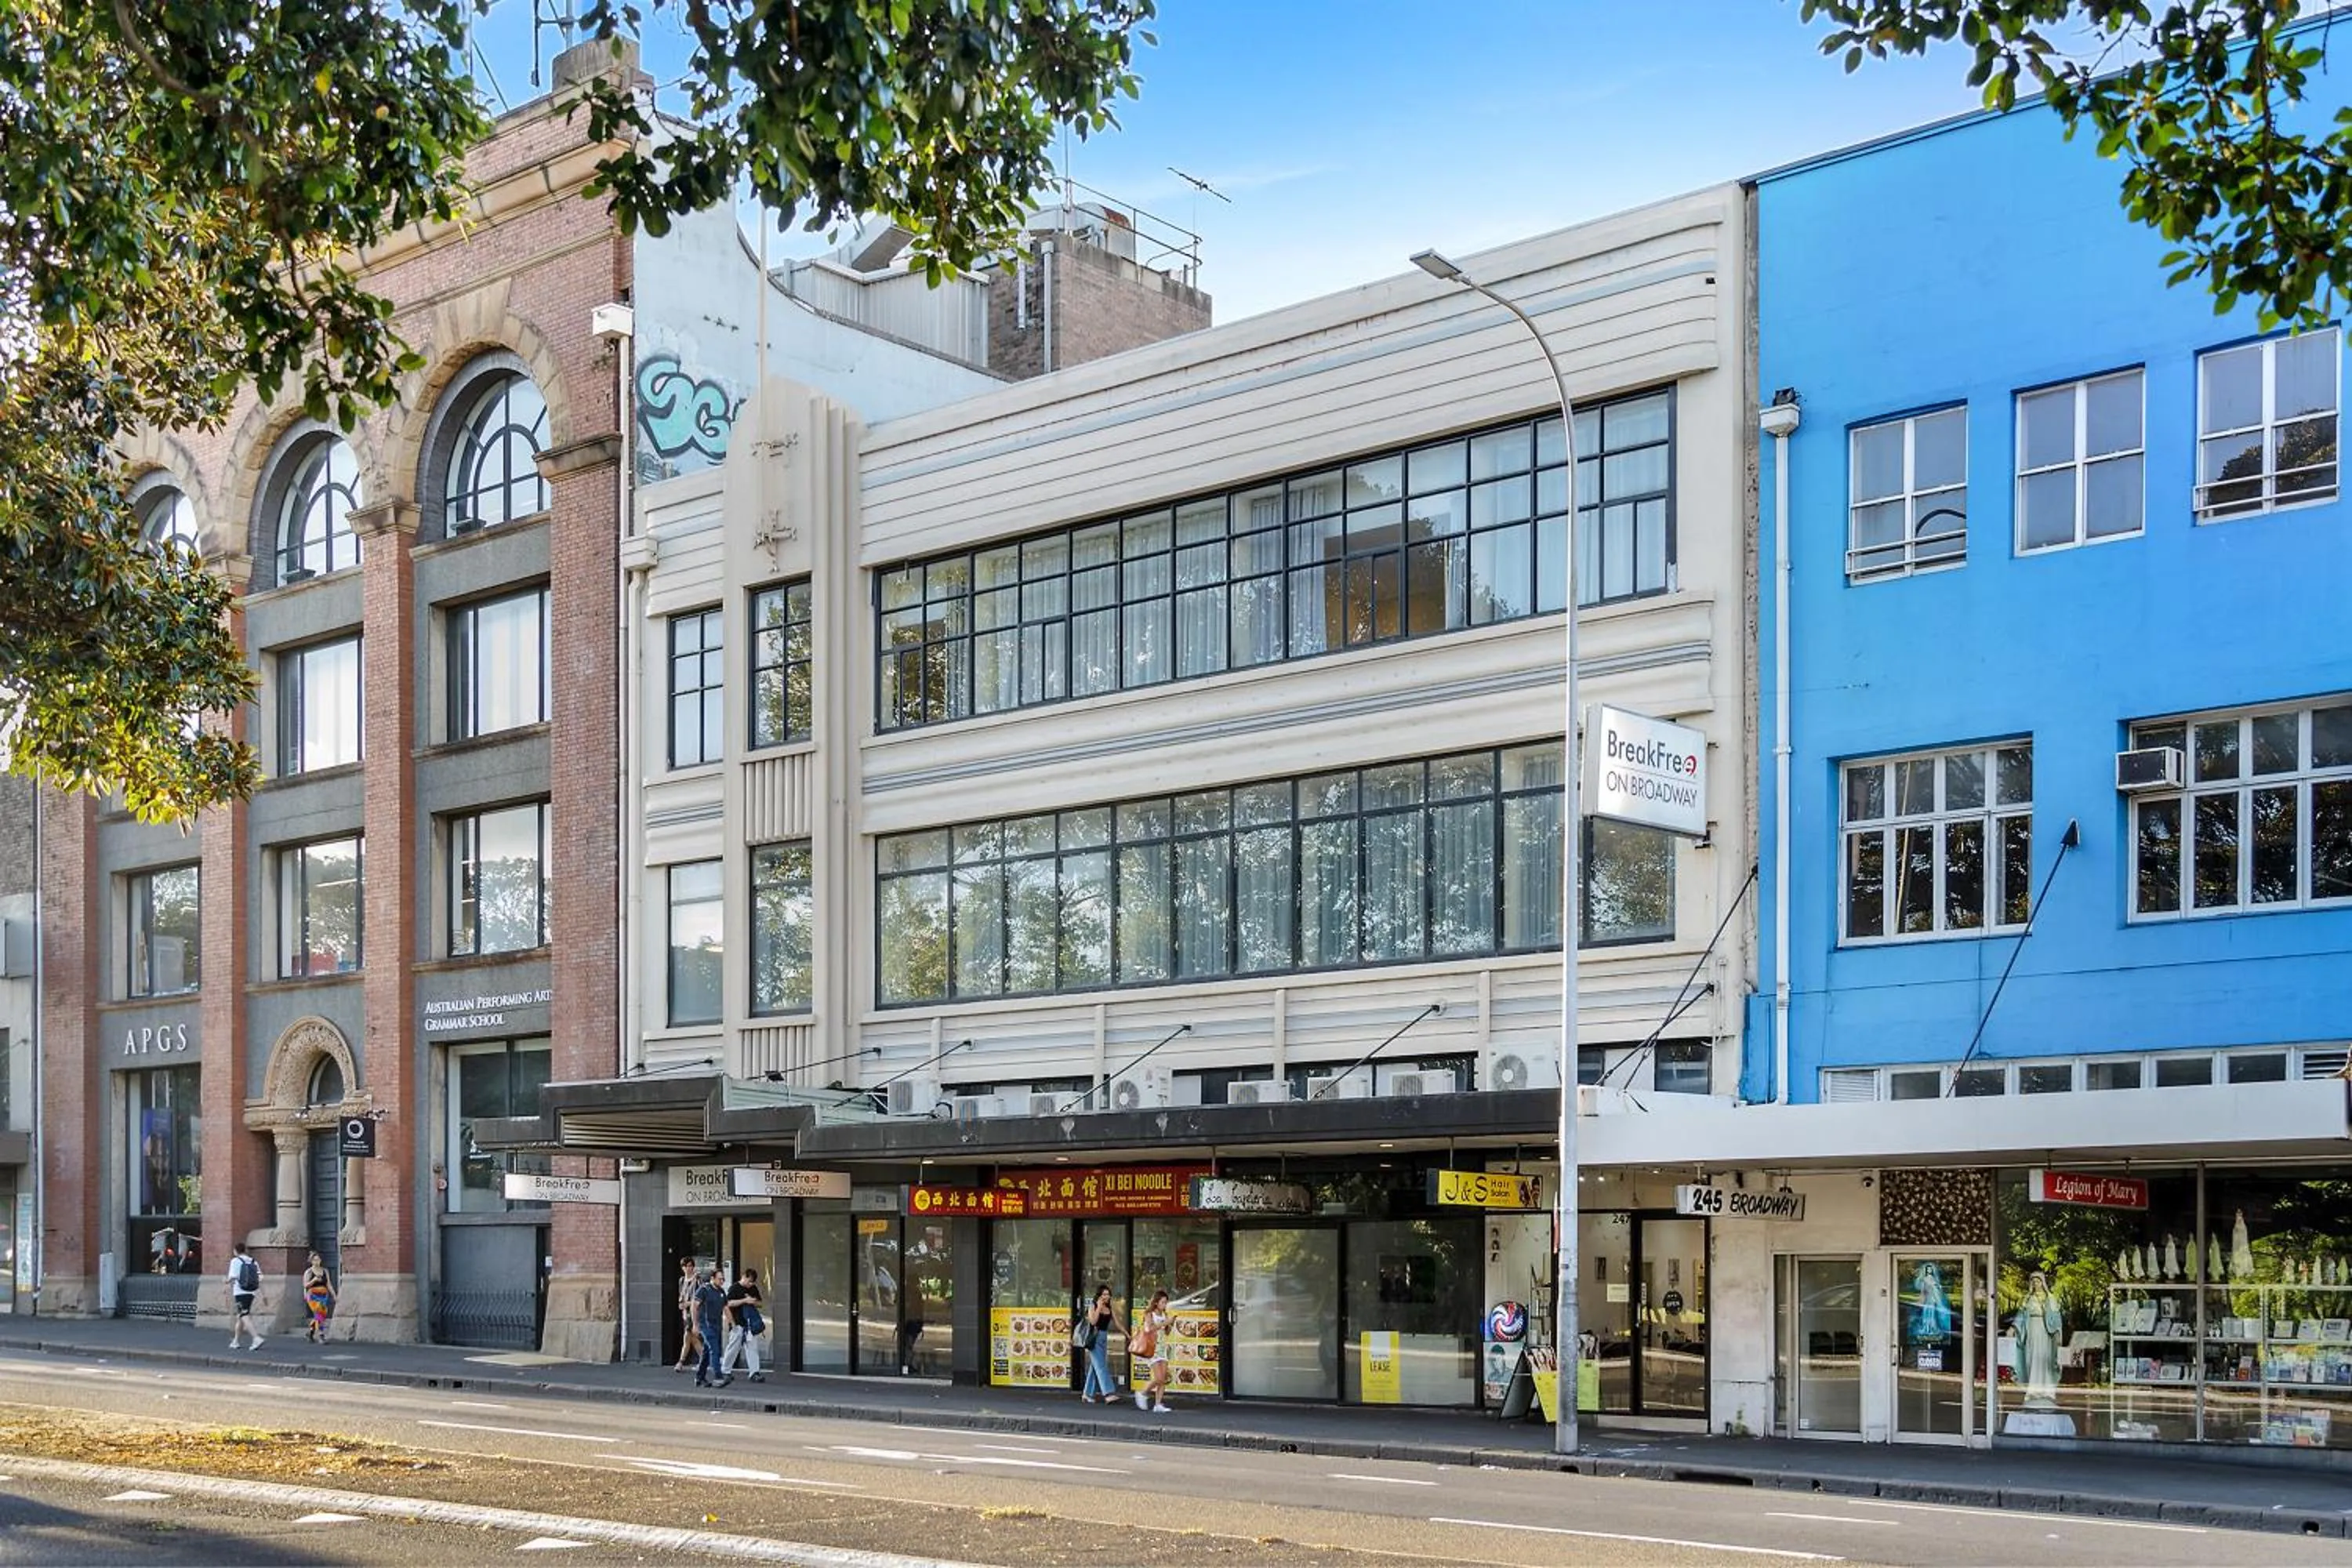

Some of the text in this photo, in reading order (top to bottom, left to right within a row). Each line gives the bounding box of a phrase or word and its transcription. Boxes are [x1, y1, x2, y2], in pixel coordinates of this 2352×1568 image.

[1608, 729, 1697, 776] BreakFree
[1606, 771, 1697, 808] ON BROADWAY
[425, 998, 474, 1014] AUSTRALIAN
[477, 992, 532, 1009] PERFORMING
[424, 1014, 506, 1031] GRAMMAR SCHOOL
[125, 1023, 187, 1054] APGS
[535, 1177, 590, 1189] BreakFree
[686, 1169, 728, 1185] BreakF
[765, 1171, 819, 1183] BreakFree
[1105, 1173, 1172, 1191] XI BEI NOODLE
[1490, 1179, 1510, 1188] Hair
[686, 1191, 701, 1203] ON
[780, 1186, 819, 1196] BROADWAY
[1490, 1189, 1511, 1197] Salon
[2055, 1176, 2138, 1205] Legion of Mary
[1693, 1189, 1799, 1217] 245 BROADWAY
[1612, 1214, 1632, 1224] 247
